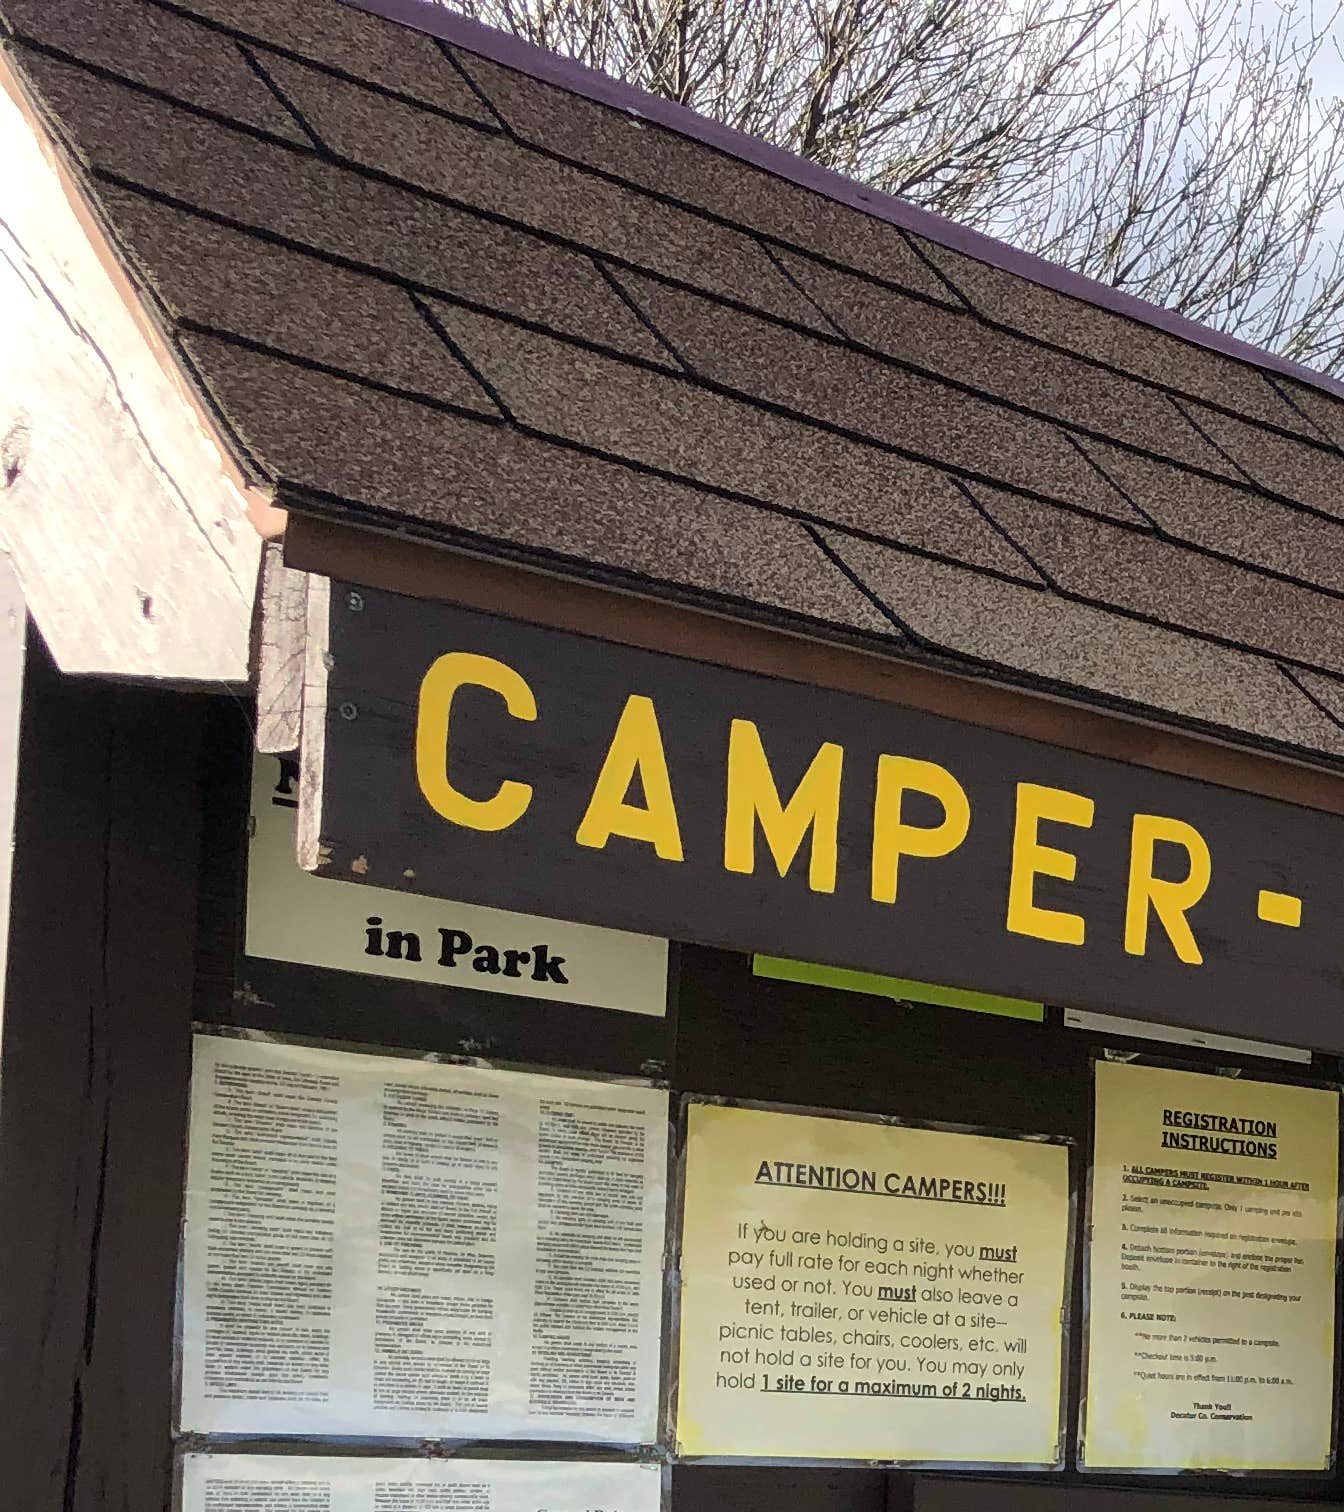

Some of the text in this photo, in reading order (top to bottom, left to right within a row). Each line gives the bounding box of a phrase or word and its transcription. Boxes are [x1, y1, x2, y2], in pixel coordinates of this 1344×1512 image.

[365, 917, 568, 984] in Park
[1163, 1109, 1277, 1138] REGISTRATION
[1161, 1131, 1277, 1159] INSTRUCTIONS
[755, 1161, 1007, 1205] ATTENTION CAMPERS!!!
[738, 1223, 1017, 1263] If you are holding a site, you must
[728, 1249, 1024, 1284] pay full rate for each night whether
[733, 1275, 1018, 1307] used or not. You must also leave a
[745, 1298, 784, 1318] tent,
[790, 1301, 842, 1321] trailer,
[848, 1309, 864, 1320] or
[869, 1308, 927, 1324] vehicle
[933, 1311, 950, 1326] at
[955, 1315, 965, 1327] a
[719, 1322, 1026, 1353] picnic tables, chairs, coolers, etc. will
[720, 1348, 1024, 1380] not hold a site for you. You may only
[716, 1372, 755, 1390] hold
[776, 1375, 805, 1391] site
[810, 1376, 833, 1392] for
[838, 1380, 849, 1392] a
[855, 1379, 937, 1396] maximum
[942, 1382, 957, 1397] of
[962, 1383, 971, 1398] 2
[976, 1384, 1027, 1402] nights.
